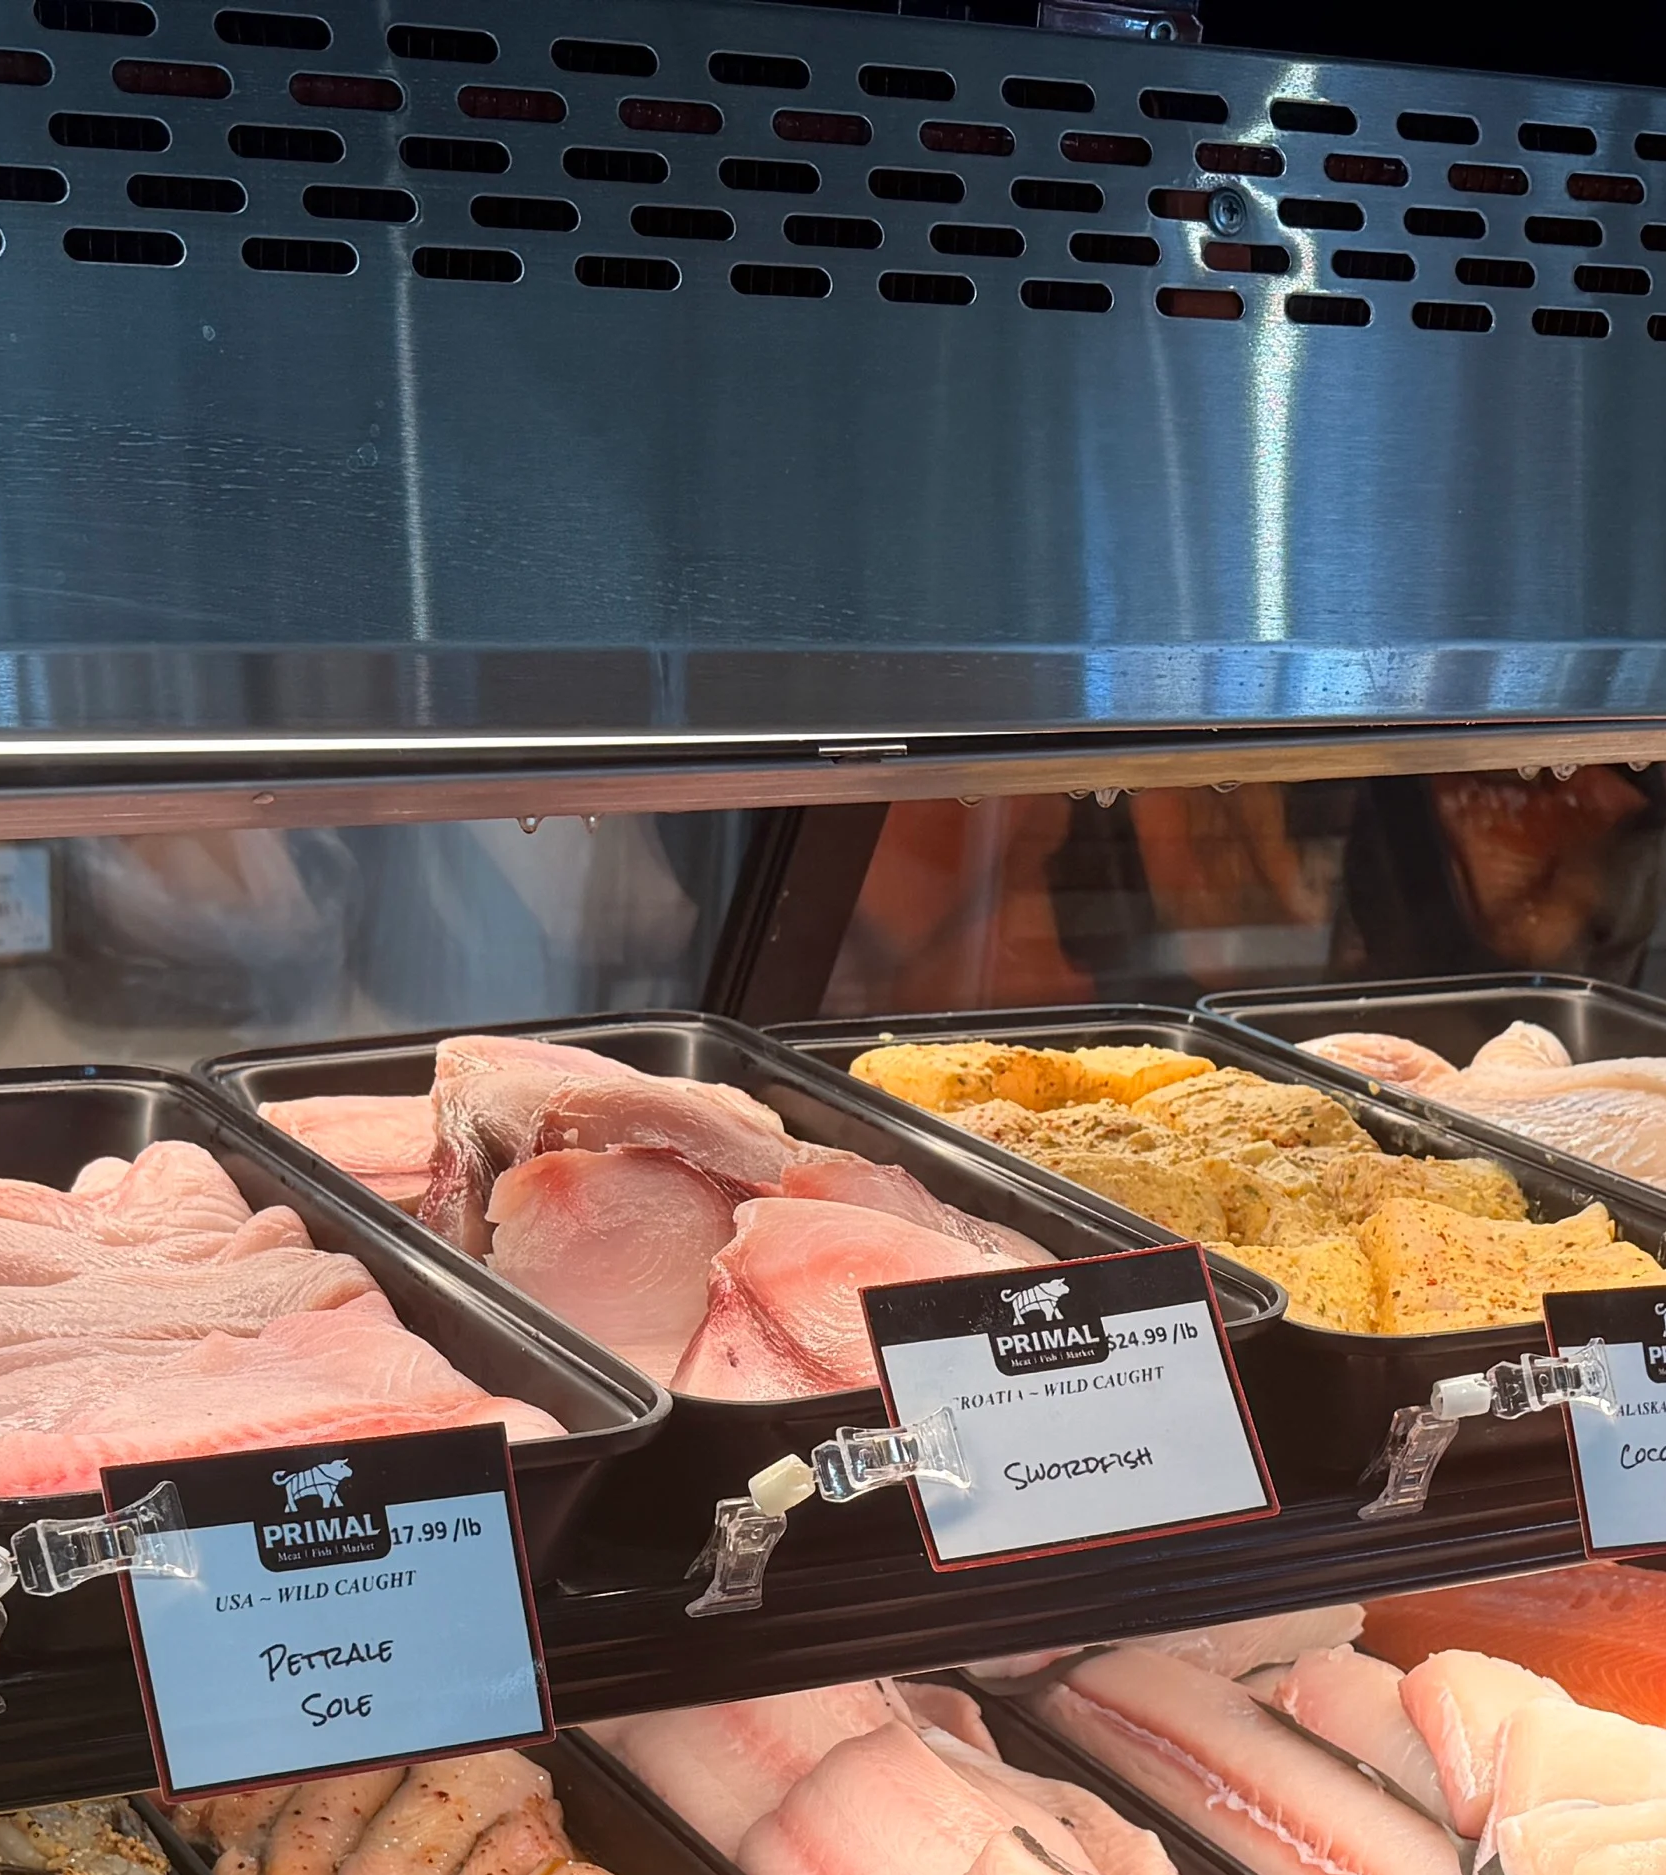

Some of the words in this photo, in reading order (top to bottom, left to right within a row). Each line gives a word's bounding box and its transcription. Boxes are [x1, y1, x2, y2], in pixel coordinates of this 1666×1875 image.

[996, 1325, 1100, 1356] PRIMAL
[1106, 1327, 1167, 1350] $24.99
[1173, 1322, 1198, 1344] /lb
[1044, 1379, 1088, 1397] WILD
[1093, 1367, 1164, 1389] CAUGHT
[1617, 1401, 1666, 1417] ALASKA
[1004, 1447, 1153, 1490] SWORDFISH
[263, 1514, 381, 1548] PRIMAL
[453, 1517, 482, 1542] /lb
[278, 1552, 301, 1562] Meat
[312, 1547, 331, 1558] Fish
[342, 1543, 375, 1555] Market
[215, 1593, 253, 1612] USA
[278, 1583, 329, 1603] WILD
[335, 1570, 416, 1595] CAUGHT
[259, 1639, 394, 1681] PETRALE
[301, 1693, 373, 1727] SOLE
